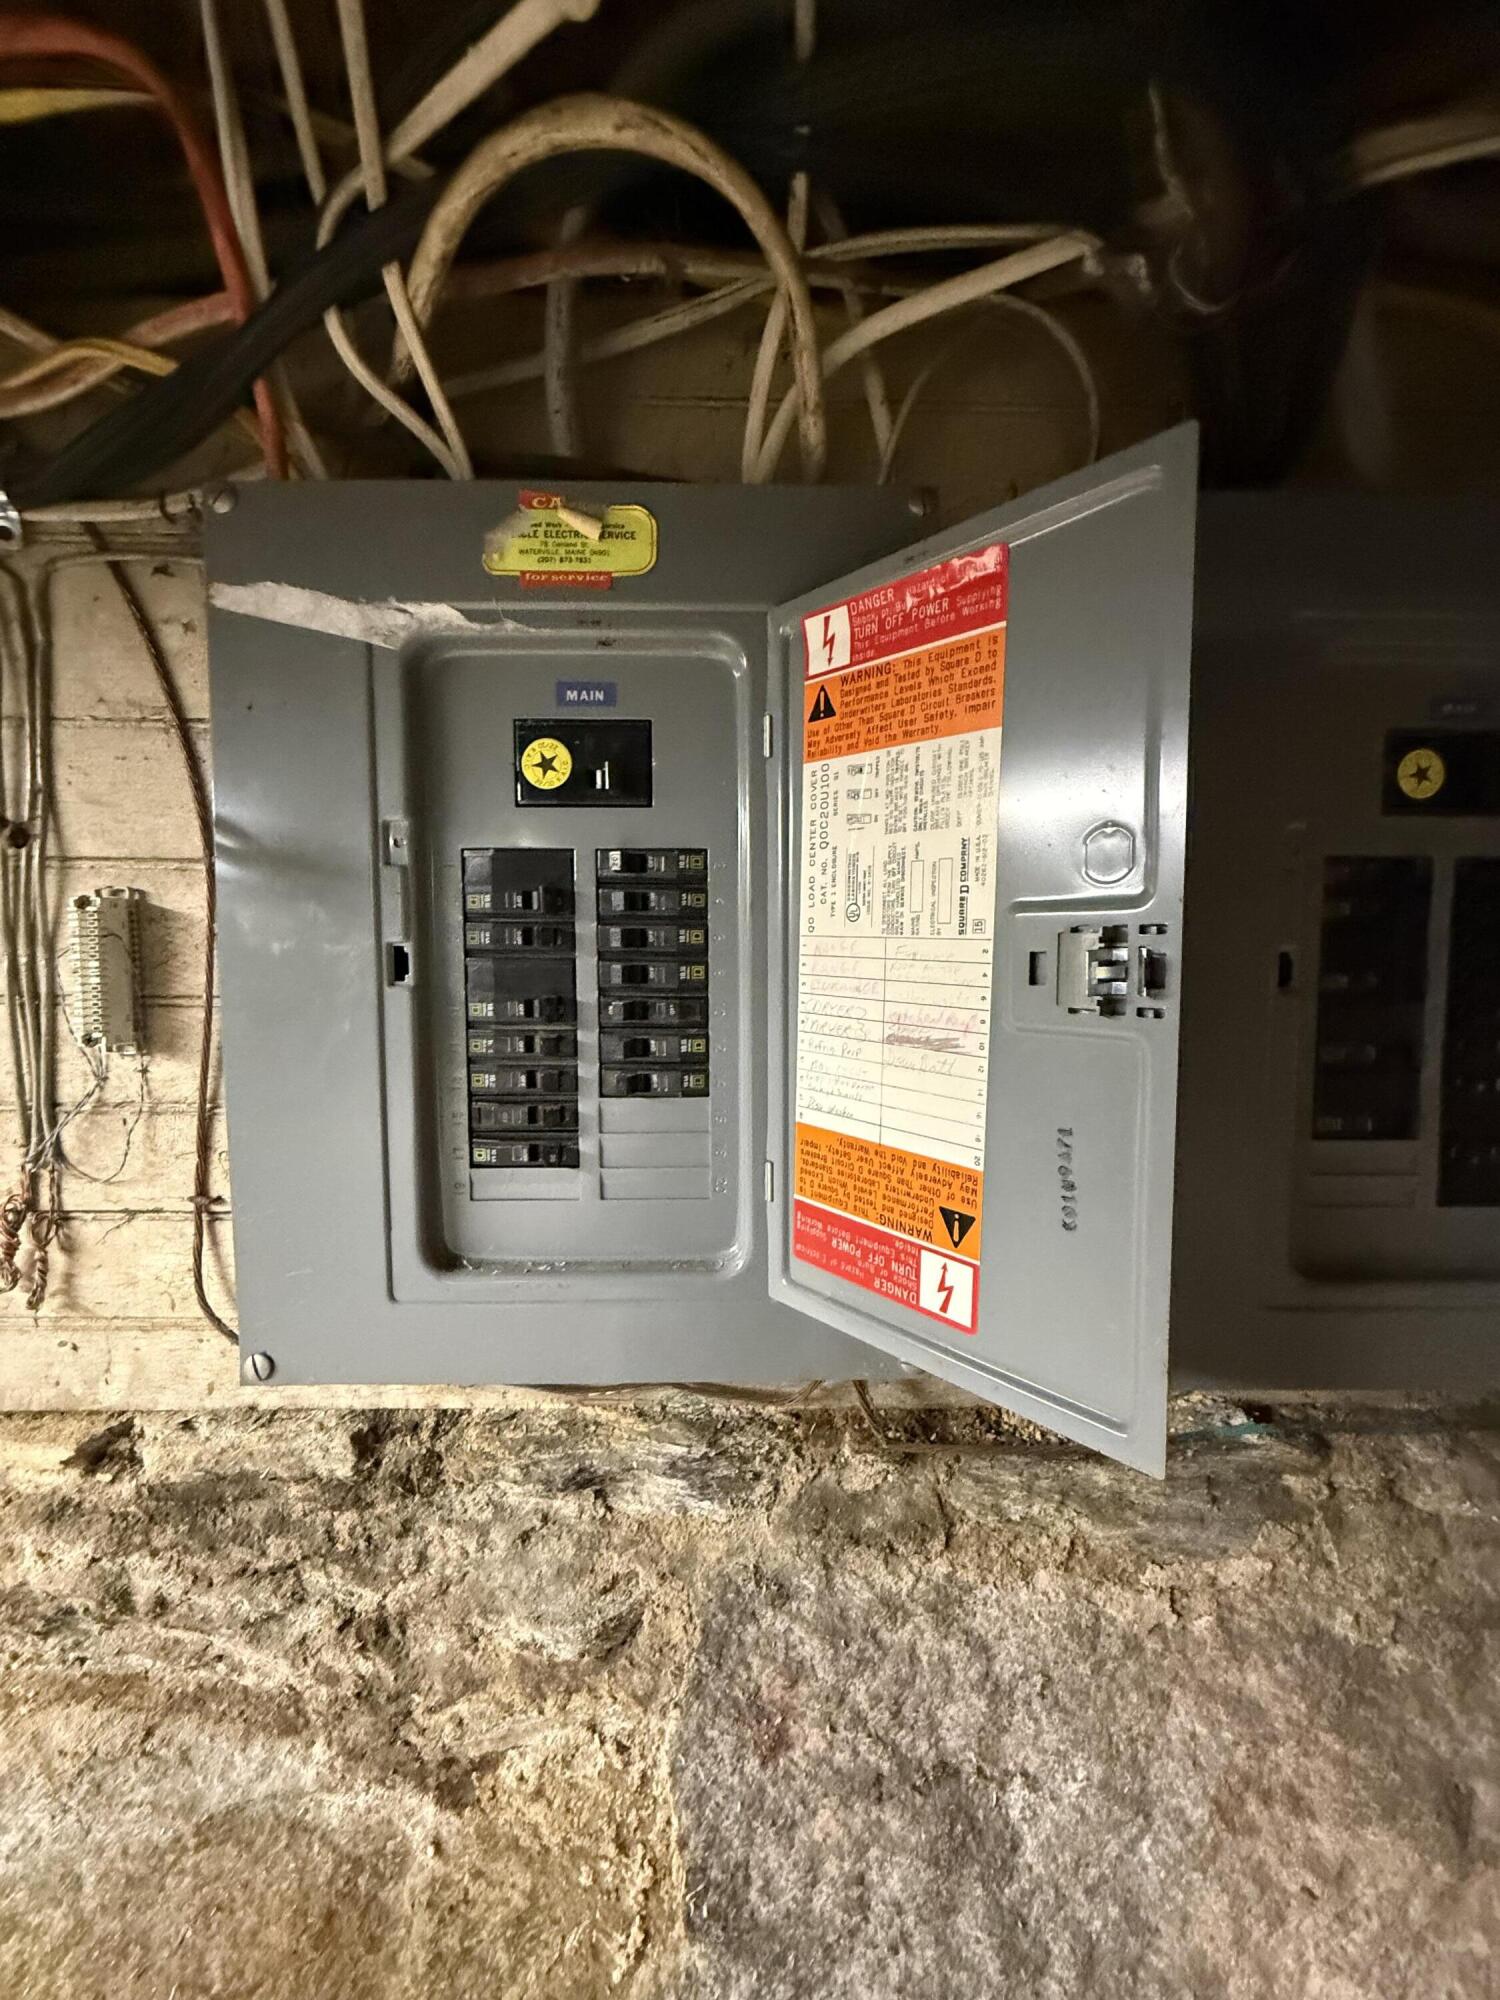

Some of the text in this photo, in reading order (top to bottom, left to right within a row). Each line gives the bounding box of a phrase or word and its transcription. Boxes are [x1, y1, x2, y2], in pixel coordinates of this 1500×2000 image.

[601, 531, 636, 540] ERVICE
[526, 572, 609, 581] for service
[850, 586, 894, 616] DANGER
[853, 615, 878, 640] TURN
[885, 611, 903, 630] OFF
[911, 595, 949, 622] POWER
[955, 581, 1002, 609] Supplying
[854, 594, 1001, 651] This Equipment Before Working
[840, 660, 895, 687] WARNING:
[903, 654, 921, 669] This
[927, 638, 980, 664] Equipment
[840, 647, 997, 700] Designed and Tested by Square D to
[566, 690, 604, 701] MAIN
[840, 659, 996, 709] Performance Levels Which Exceed
[807, 685, 995, 738] Use of Other Than Square D Circuit Breakers
[840, 700, 886, 720] Underwriters
[891, 686, 942, 708] Laboratories
[807, 738, 820, 751] May
[825, 728, 860, 746] Adversely
[866, 721, 891, 735] Affect
[897, 715, 917, 729] User
[807, 721, 942, 760] Reliability and Void the Warranty.
[807, 769, 817, 932] QO LOAD CENTER COVER
[959, 836, 968, 882] COMPANY
[959, 884, 969, 894] D
[957, 895, 966, 935] SQUARE
[836, 1136, 978, 1187] Reliability and Void the Warranty.
[856, 1153, 873, 1168] User
[878, 1160, 904, 1177] Affect
[799, 1165, 934, 1218] Performance Levels Which Exceed
[800, 1147, 977, 1210] Use of Other Than Square D Circuit Breakers
[836, 1167, 880, 1190] Laboratories
[910, 1166, 953, 1191] Adversely
[959, 1181, 977, 1198] May
[799, 1175, 933, 1229] Designed and Tested by Square D to
[810, 1187, 848, 1211] Equipment
[884, 1182, 934, 1207] Underwriters
[853, 1203, 869, 1218] This
[826, 1223, 850, 1242] Before
[875, 1211, 933, 1243] WARNING:
[831, 1234, 861, 1258] POWER
[855, 1232, 895, 1260] Equipment
[867, 1249, 884, 1268] OFF
[899, 1252, 917, 1268] This
[891, 1259, 917, 1282] TURN
[892, 1272, 917, 1292] Shock
[873, 1274, 916, 1306] DANGER
